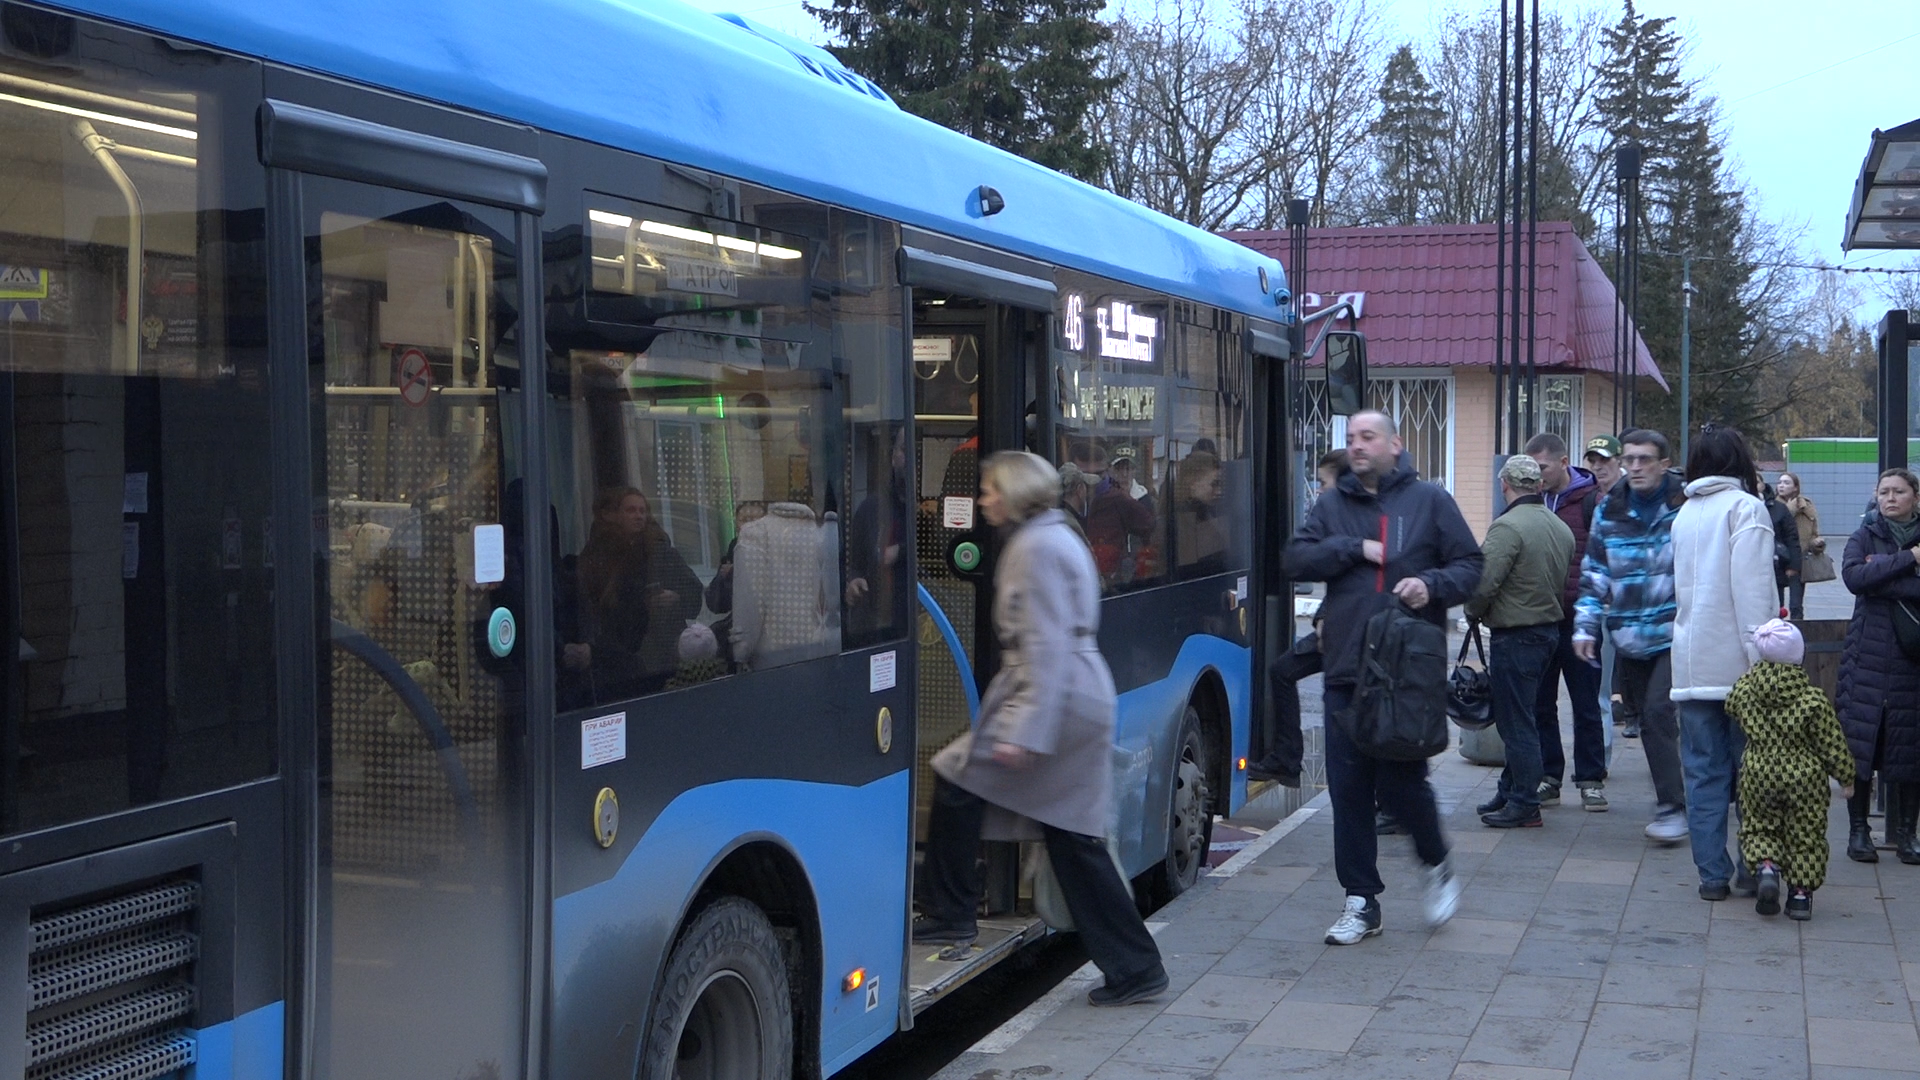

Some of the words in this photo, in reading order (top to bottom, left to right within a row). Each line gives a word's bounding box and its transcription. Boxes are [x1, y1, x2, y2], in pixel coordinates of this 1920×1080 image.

[1065, 294, 1084, 351] 46
[1587, 438, 1609, 449] СССР
[585, 723, 598, 732] ПРИ
[599, 717, 623, 728] АВАРИИ
